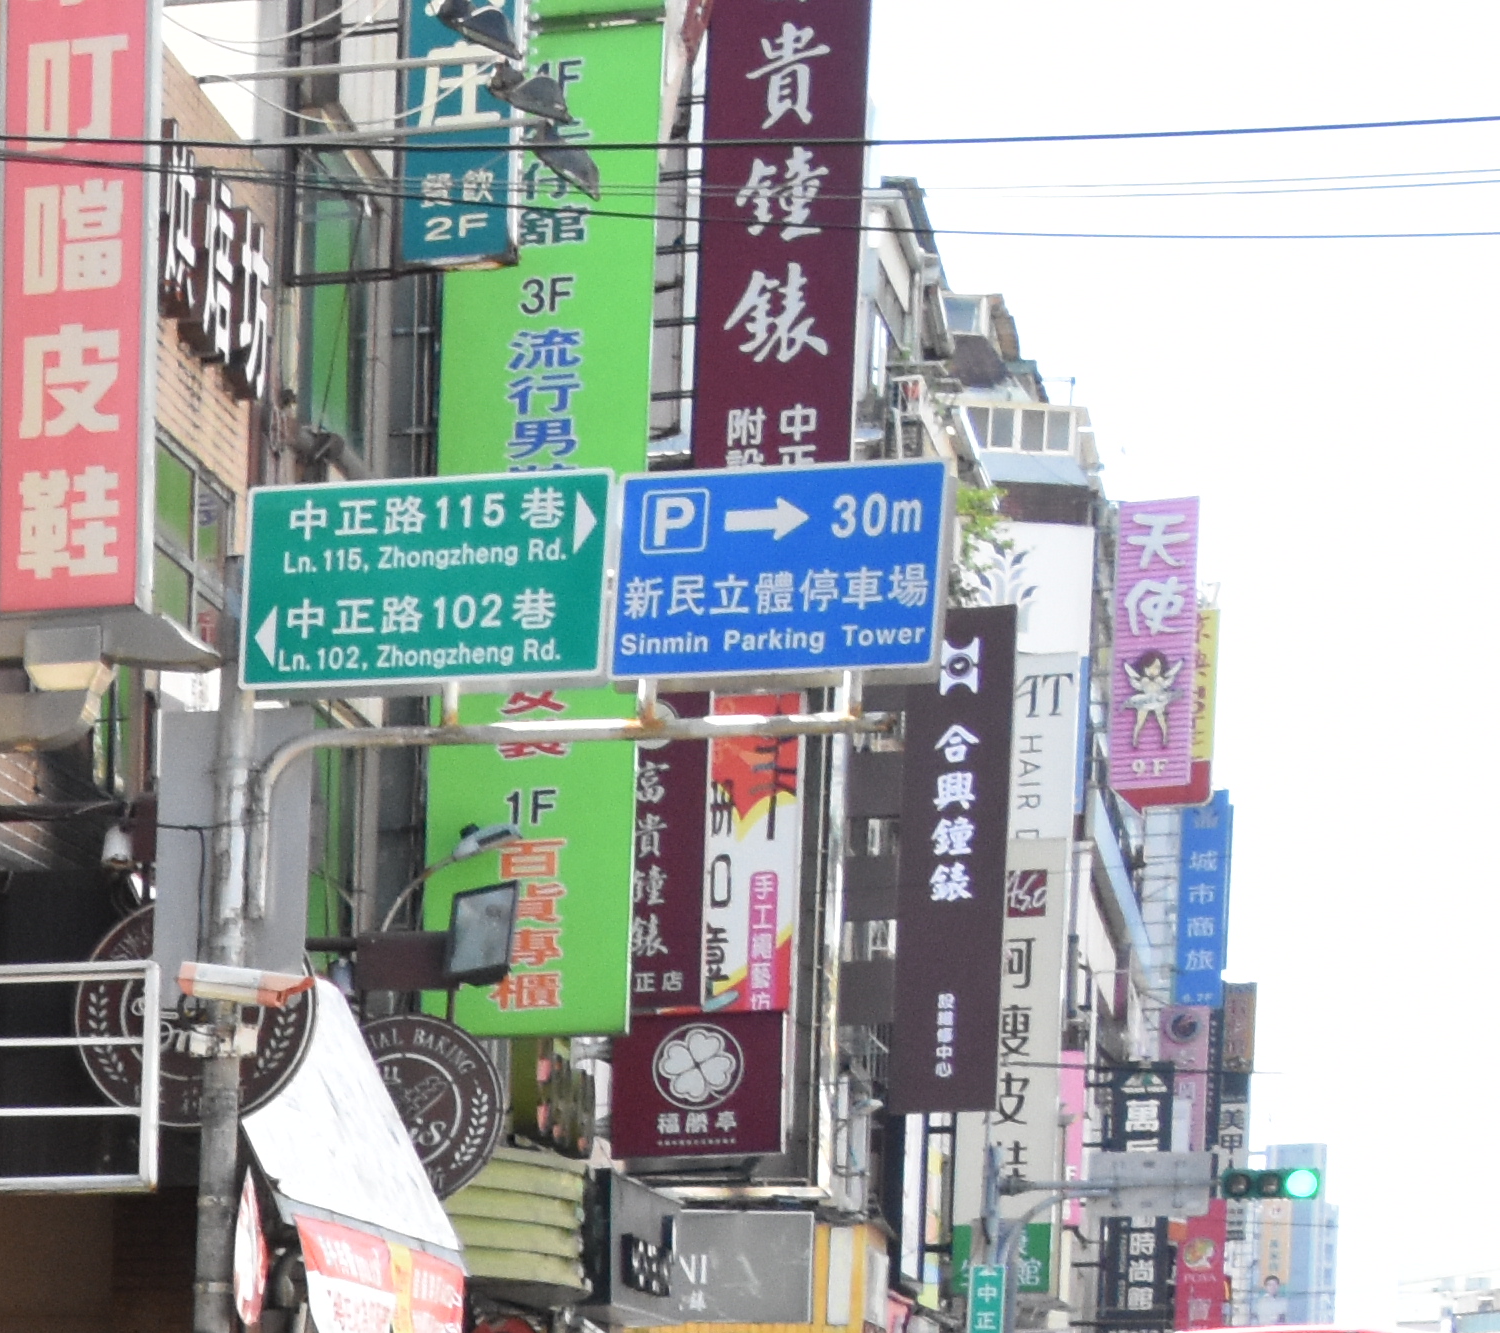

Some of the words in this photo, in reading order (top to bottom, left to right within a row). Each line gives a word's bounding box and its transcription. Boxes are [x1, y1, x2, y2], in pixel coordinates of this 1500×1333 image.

[724, 21, 829, 363] 貴鐘錶
[424, 213, 488, 242] 2F
[17, 0, 129, 580] 叮噹皮鞋
[520, 277, 574, 315] 3F
[507, 328, 582, 473] 流行男
[830, 494, 923, 540] 30m
[283, 550, 315, 573] Ln.
[324, 549, 369, 574] 115,
[377, 542, 518, 572] Zhongzheng
[527, 538, 566, 562] Rd.
[1127, 514, 1190, 636] 天使
[623, 567, 930, 622] 新民立體停車場
[277, 650, 310, 673] Ln.
[318, 648, 366, 673] 102,
[376, 641, 514, 671] Zhongzheng
[523, 636, 562, 662] Rd.
[620, 627, 709, 657] Sinmin
[723, 626, 828, 657] Parking
[841, 620, 926, 648] Tower
[1018, 735, 1042, 810] HAIR
[1132, 758, 1168, 777] 9F
[506, 789, 557, 825] 1F
[930, 724, 980, 902] 合興鐘錶
[414, 1028, 478, 1075] BAKING
